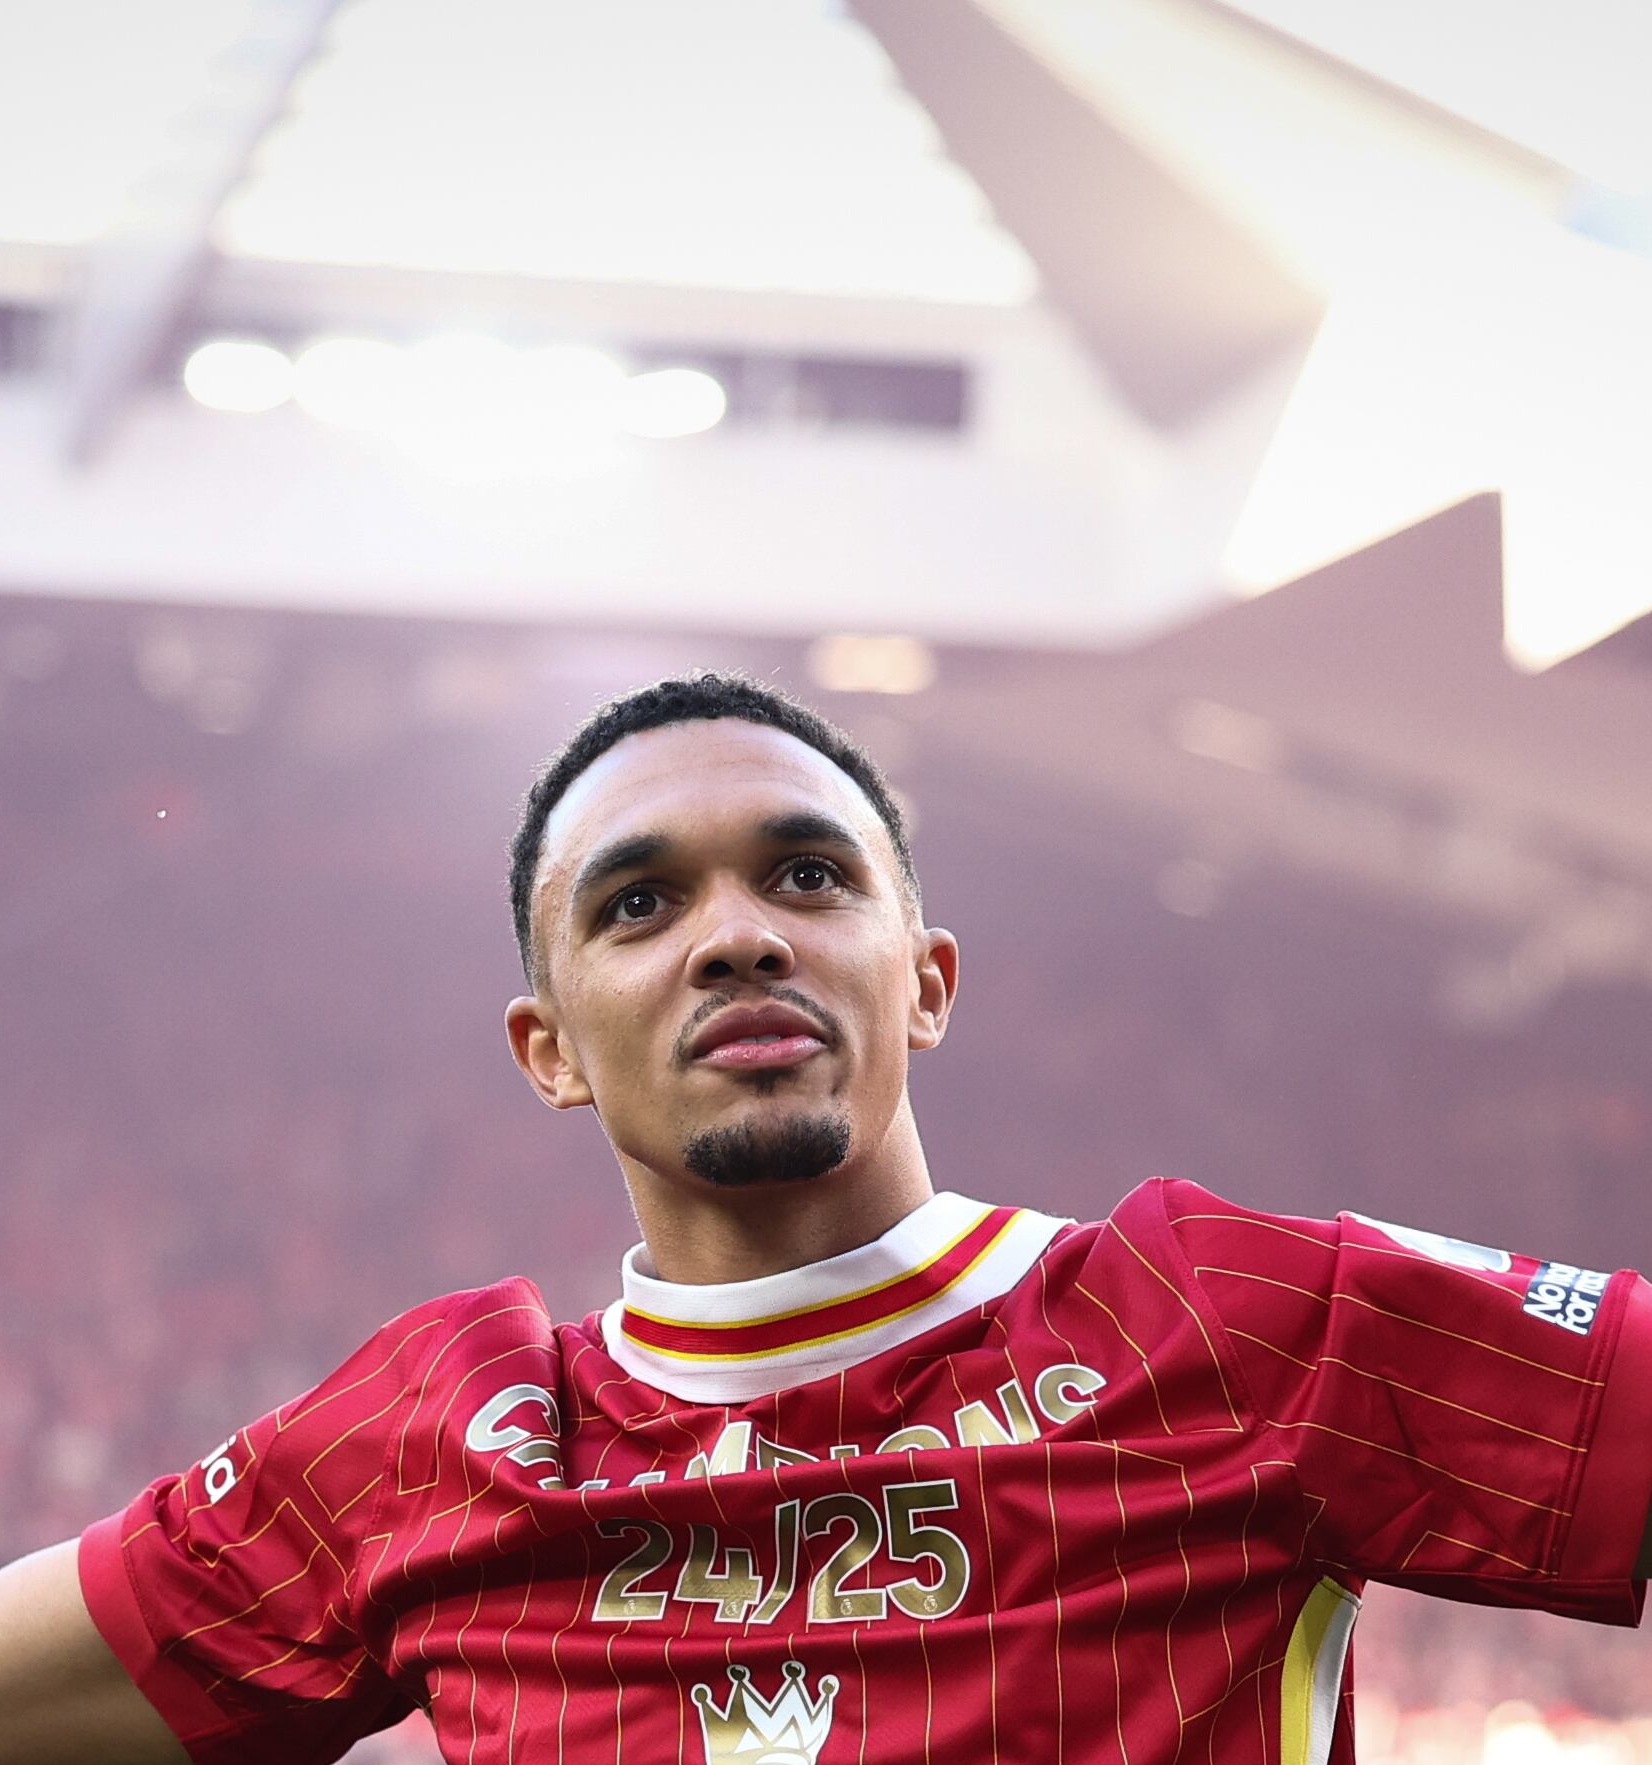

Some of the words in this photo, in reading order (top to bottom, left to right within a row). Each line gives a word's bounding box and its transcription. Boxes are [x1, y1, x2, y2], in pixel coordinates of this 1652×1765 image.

[1523, 1283, 1566, 1324] No
[1555, 1293, 1597, 1335] For
[591, 1478, 972, 1625] 24/25
